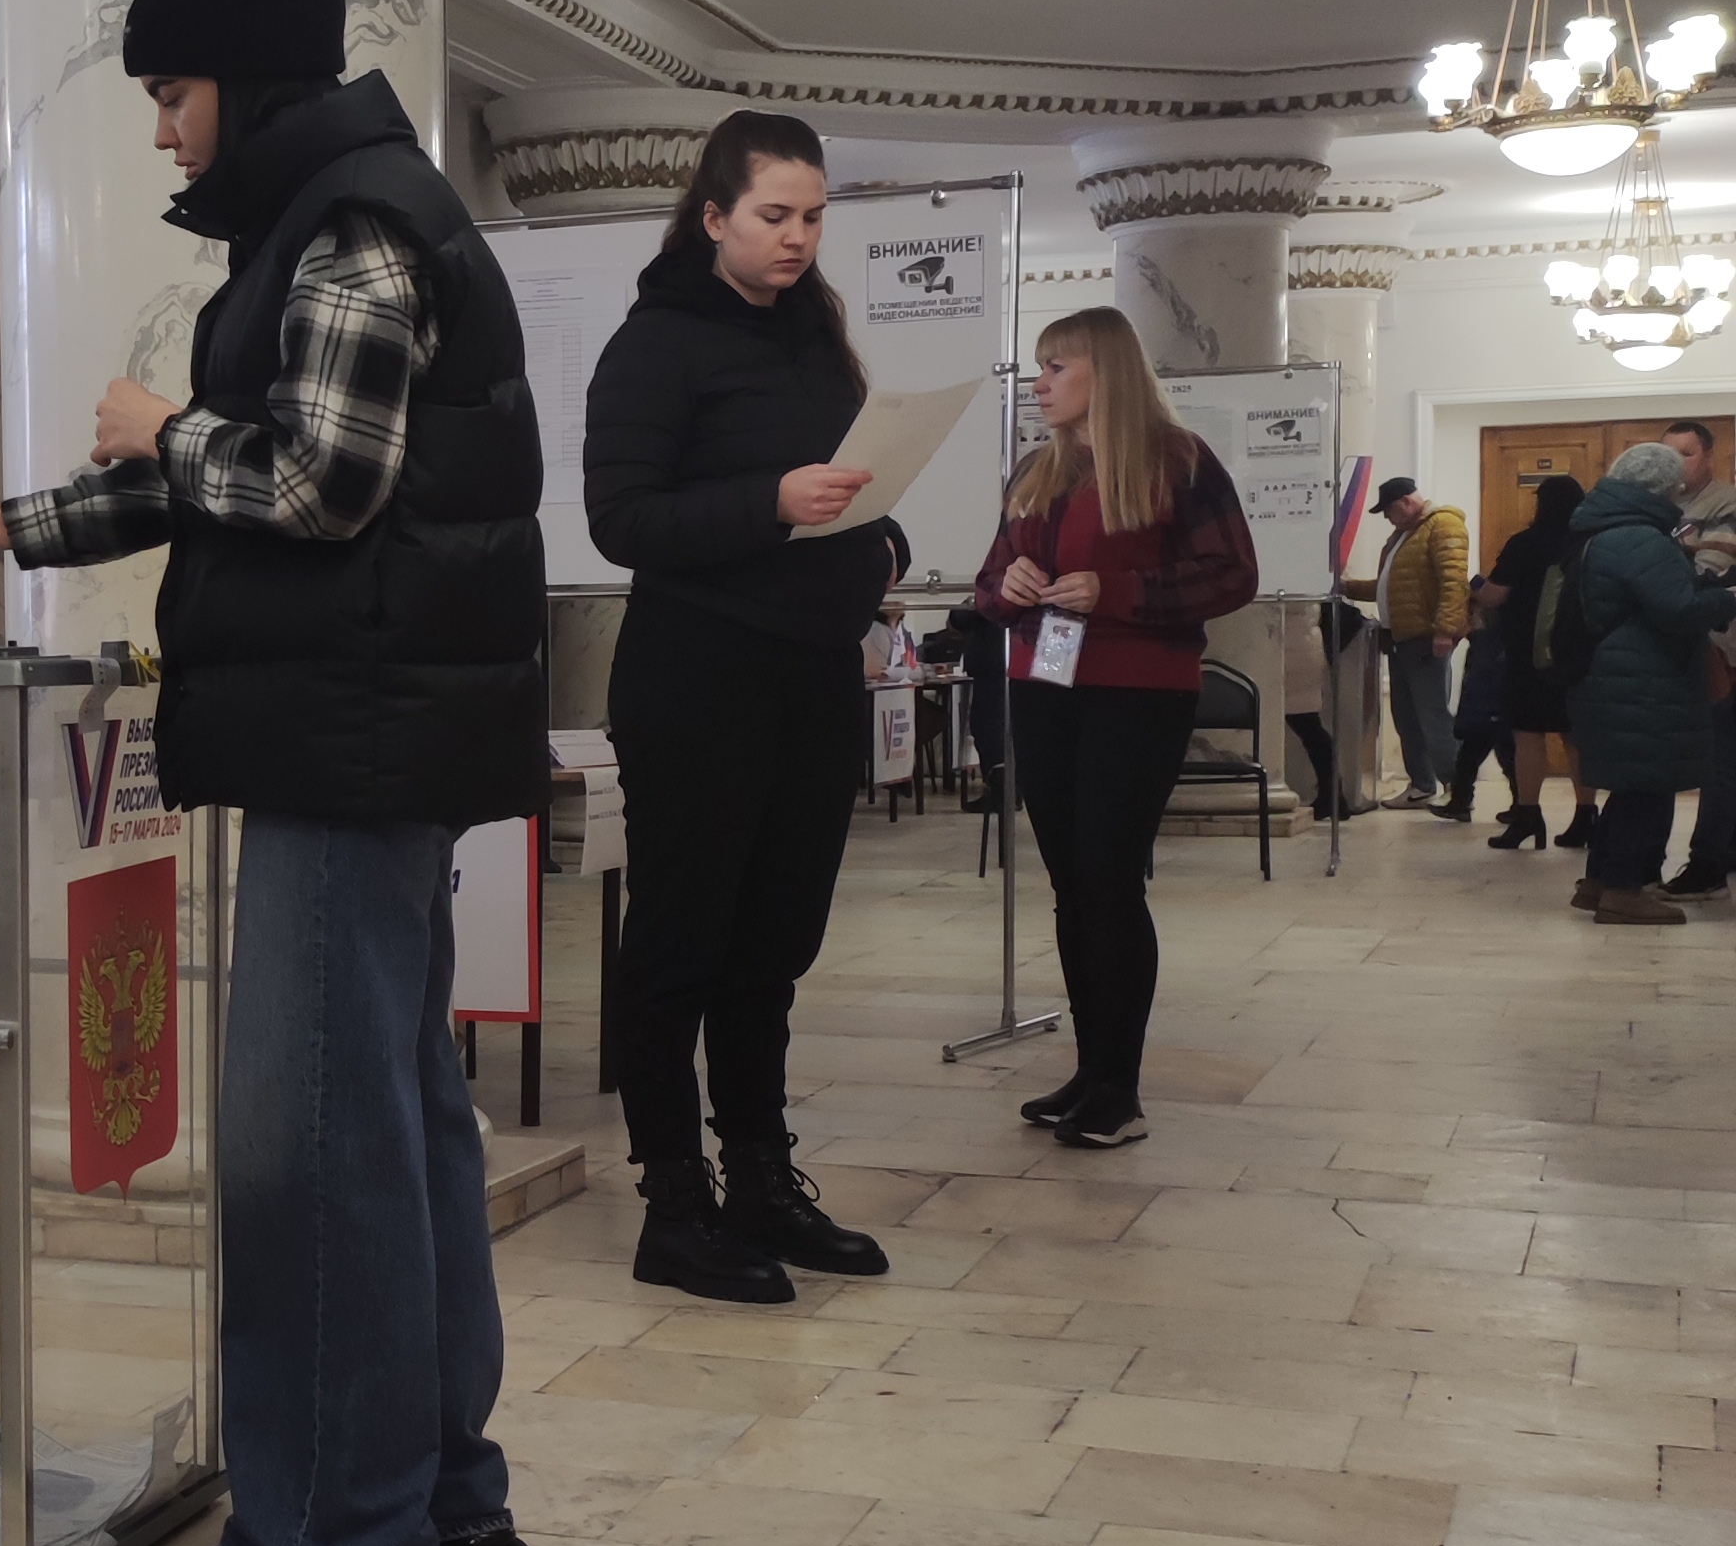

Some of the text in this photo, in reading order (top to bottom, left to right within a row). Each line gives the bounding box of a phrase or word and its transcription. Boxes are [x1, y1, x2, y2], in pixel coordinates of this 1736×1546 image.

[869, 237, 982, 260] ВНИМАНИЕ!
[869, 296, 982, 311] В ПОМЕЩЕНИИ ВЕДЕТСЯ
[869, 305, 981, 321] ВИДЕОНАБЛЮДЕНИЕ
[1247, 407, 1320, 421] ВНИМАНИЕ!
[126, 717, 154, 744] ВЫБ
[119, 752, 159, 779] ПРЕЗИ
[113, 784, 160, 815] РОССИИ
[132, 817, 160, 841] МАРТА
[160, 814, 182, 838] 2024
